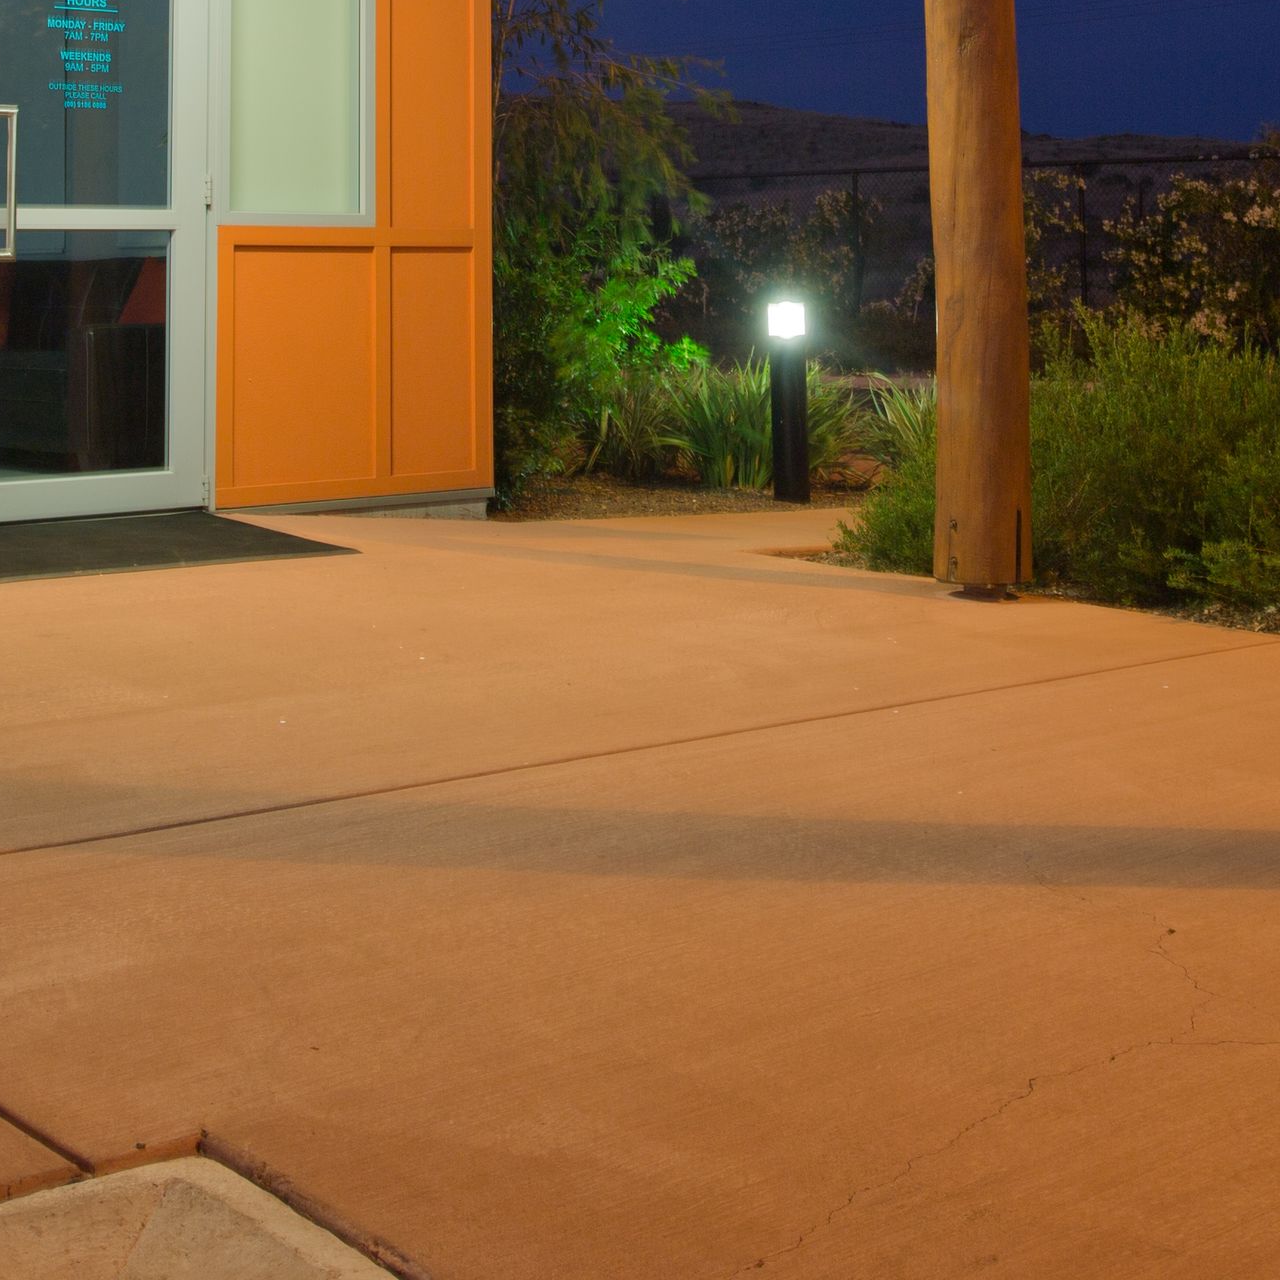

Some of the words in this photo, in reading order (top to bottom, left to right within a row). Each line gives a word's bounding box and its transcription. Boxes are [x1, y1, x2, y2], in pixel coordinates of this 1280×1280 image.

[48, 18, 86, 29] MONDAY
[93, 22, 125, 32] FRIDAY
[65, 31, 83, 40] 7AM
[90, 32, 109, 41] 7PM
[61, 51, 111, 62] WEEKENDS
[65, 62, 83, 72] 9AM
[90, 63, 109, 73] 5PM
[48, 83, 77, 91] OUTSIDE
[78, 84, 99, 92] THESE
[100, 85, 123, 93] HOURS
[65, 91, 90, 99] PLEASE
[91, 92, 106, 100] CALL
